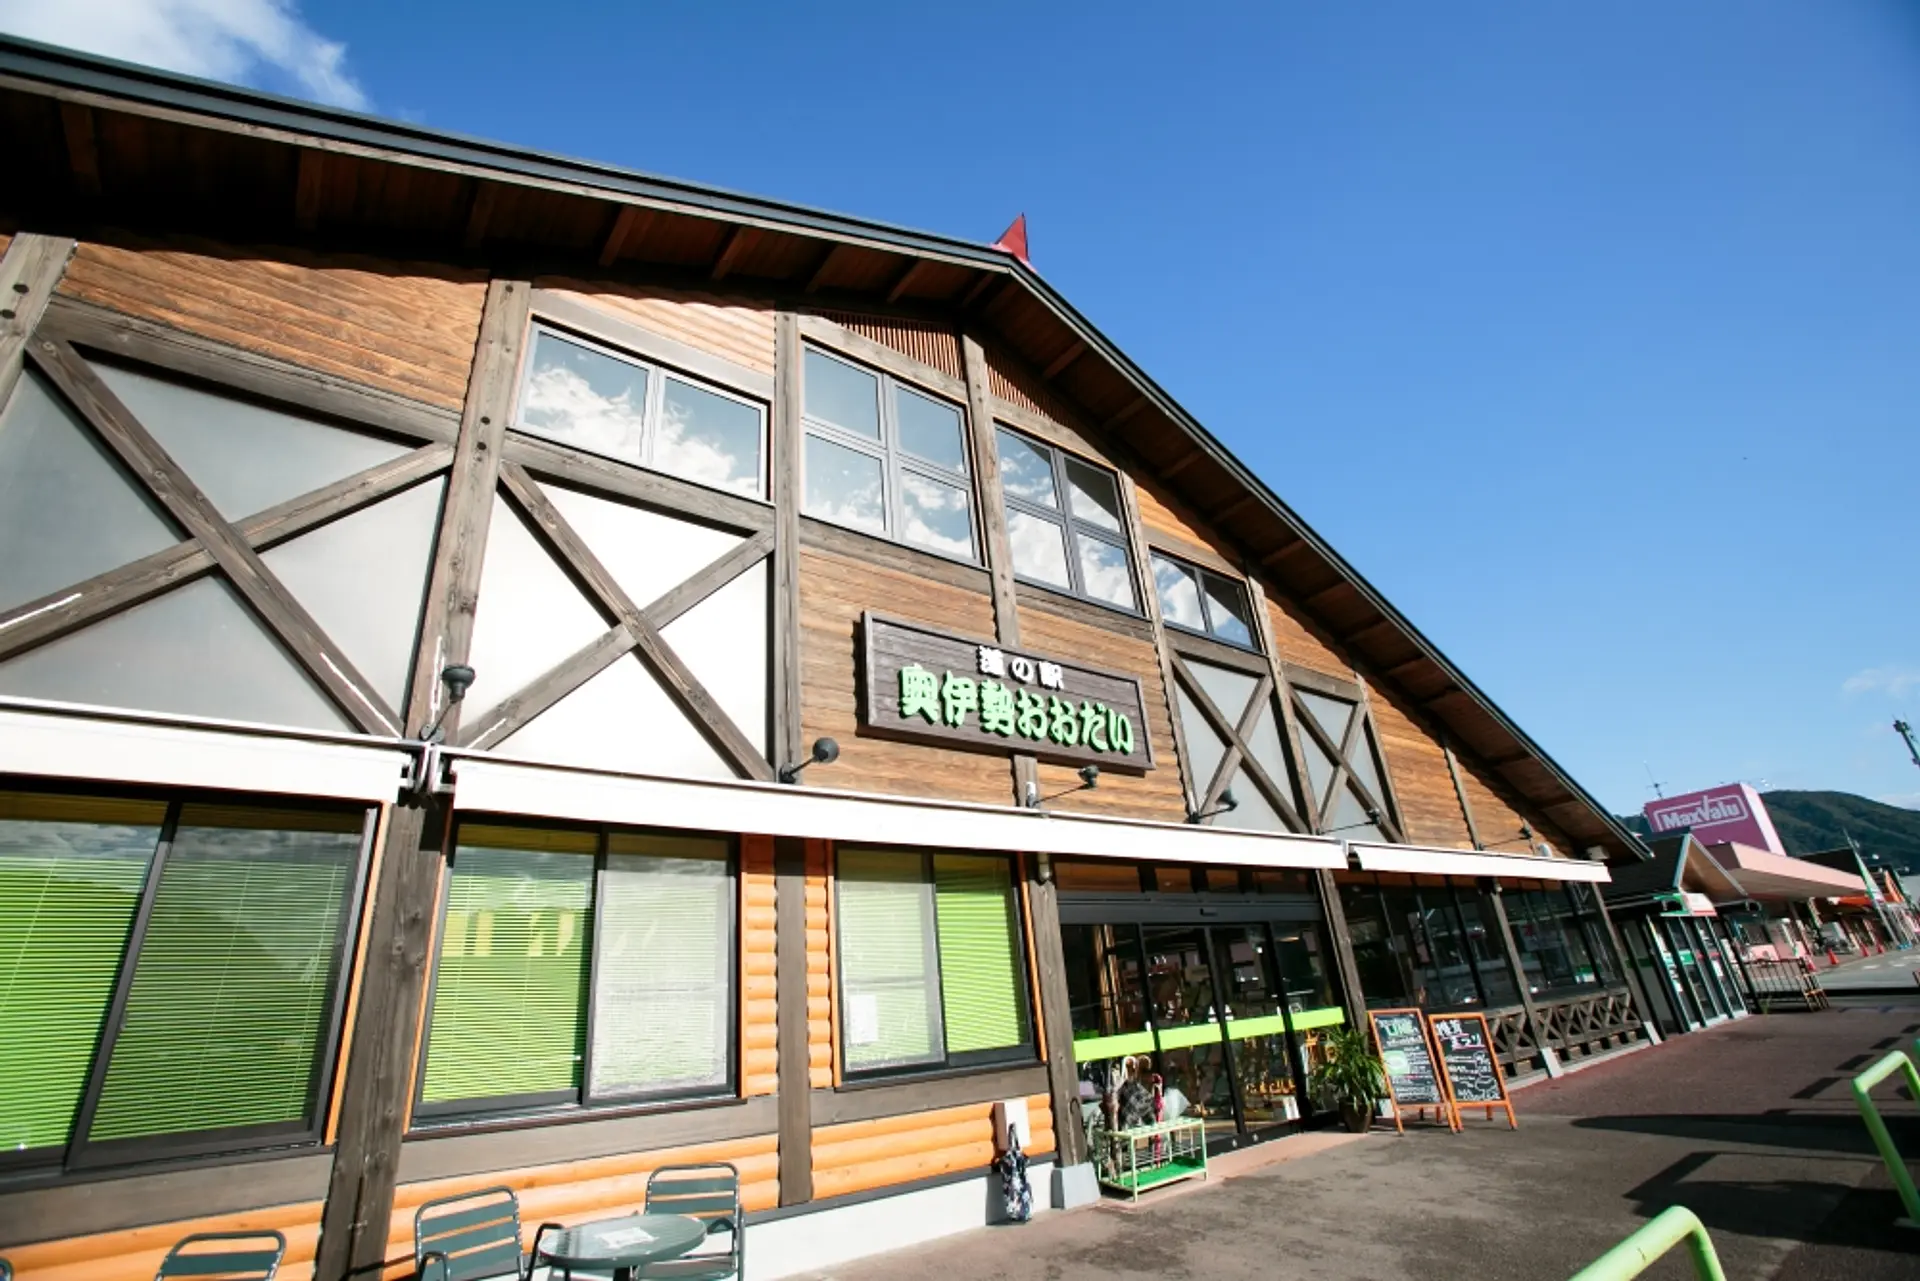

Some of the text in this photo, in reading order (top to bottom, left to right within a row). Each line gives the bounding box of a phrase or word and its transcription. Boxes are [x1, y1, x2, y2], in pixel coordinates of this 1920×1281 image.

[900, 663, 1134, 754] 奥伊勢おおだい
[1661, 795, 1740, 829] MaxValu
